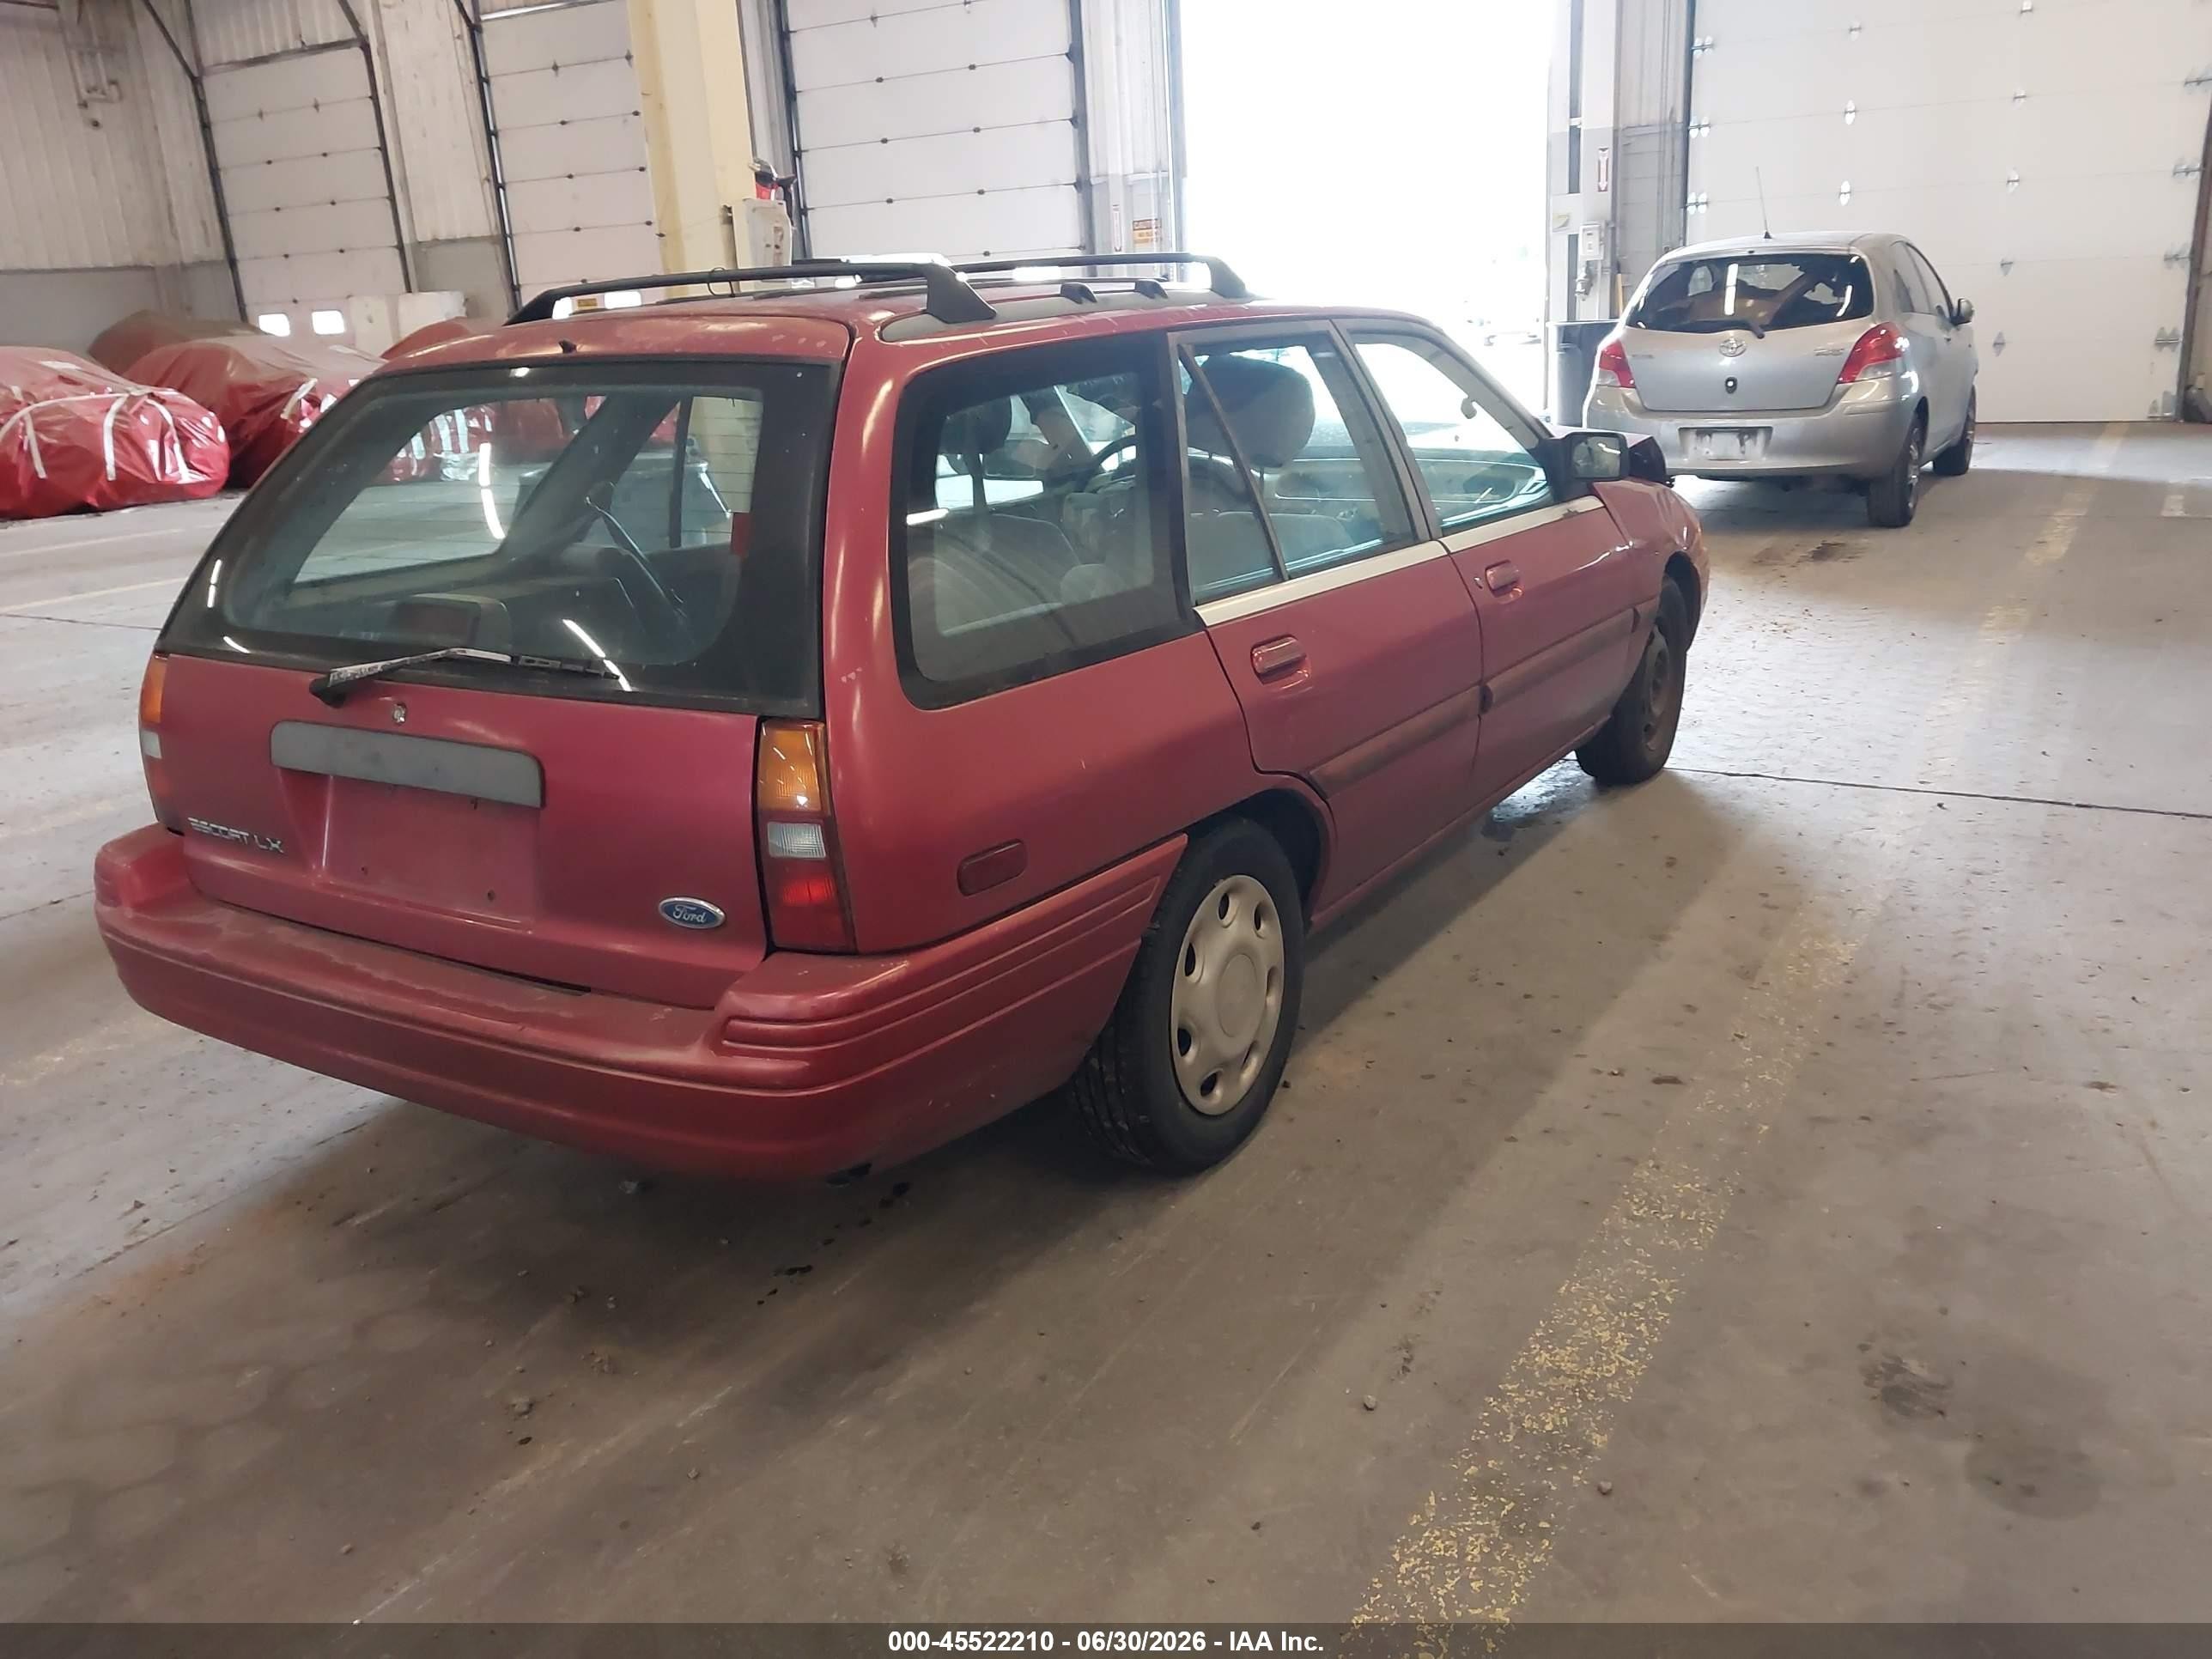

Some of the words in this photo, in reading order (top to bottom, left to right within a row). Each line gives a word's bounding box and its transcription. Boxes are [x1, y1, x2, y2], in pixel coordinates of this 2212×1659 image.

[187, 817, 249, 845] ESCORT
[253, 835, 284, 854] LX
[672, 904, 708, 923] Ford
